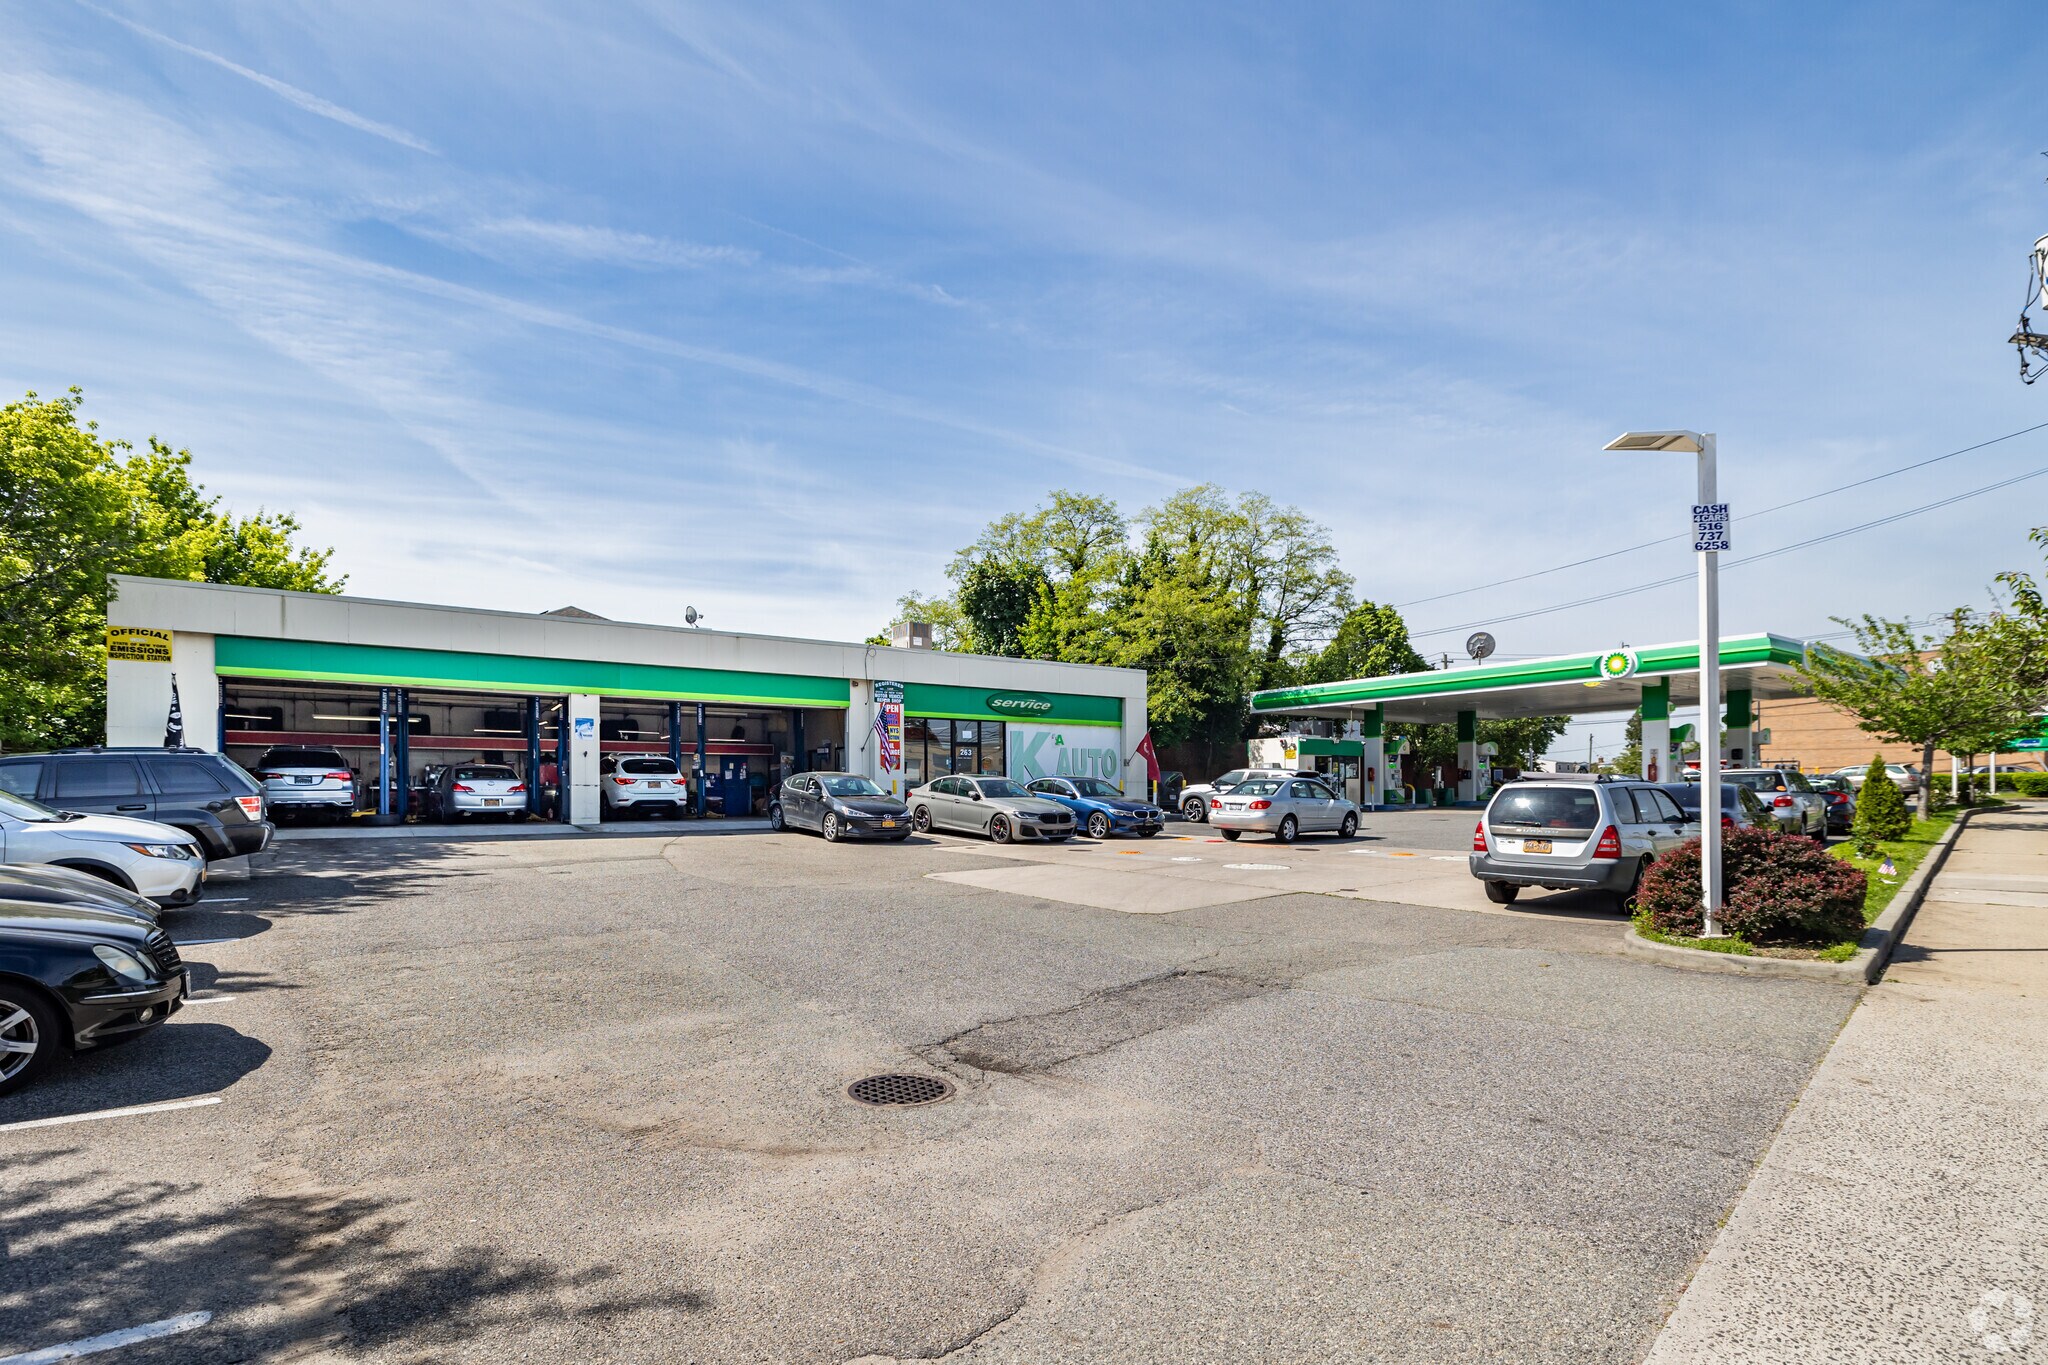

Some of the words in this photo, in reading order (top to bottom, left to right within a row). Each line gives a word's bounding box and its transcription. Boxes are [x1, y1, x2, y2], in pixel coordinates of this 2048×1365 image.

[1693, 504, 1728, 514] CASH
[1698, 522, 1723, 531] 516
[1698, 531, 1723, 541] 737
[1694, 540, 1729, 551] 6258
[110, 628, 169, 641] OFFICIAL
[110, 645, 169, 655] EMISSIONS
[108, 652, 144, 660] INSPECTION
[875, 681, 904, 689] REGISTERED
[886, 704, 899, 712] PEN
[991, 698, 1051, 710] service
[1010, 730, 1050, 784] K
[1055, 747, 1117, 779] AUTO
